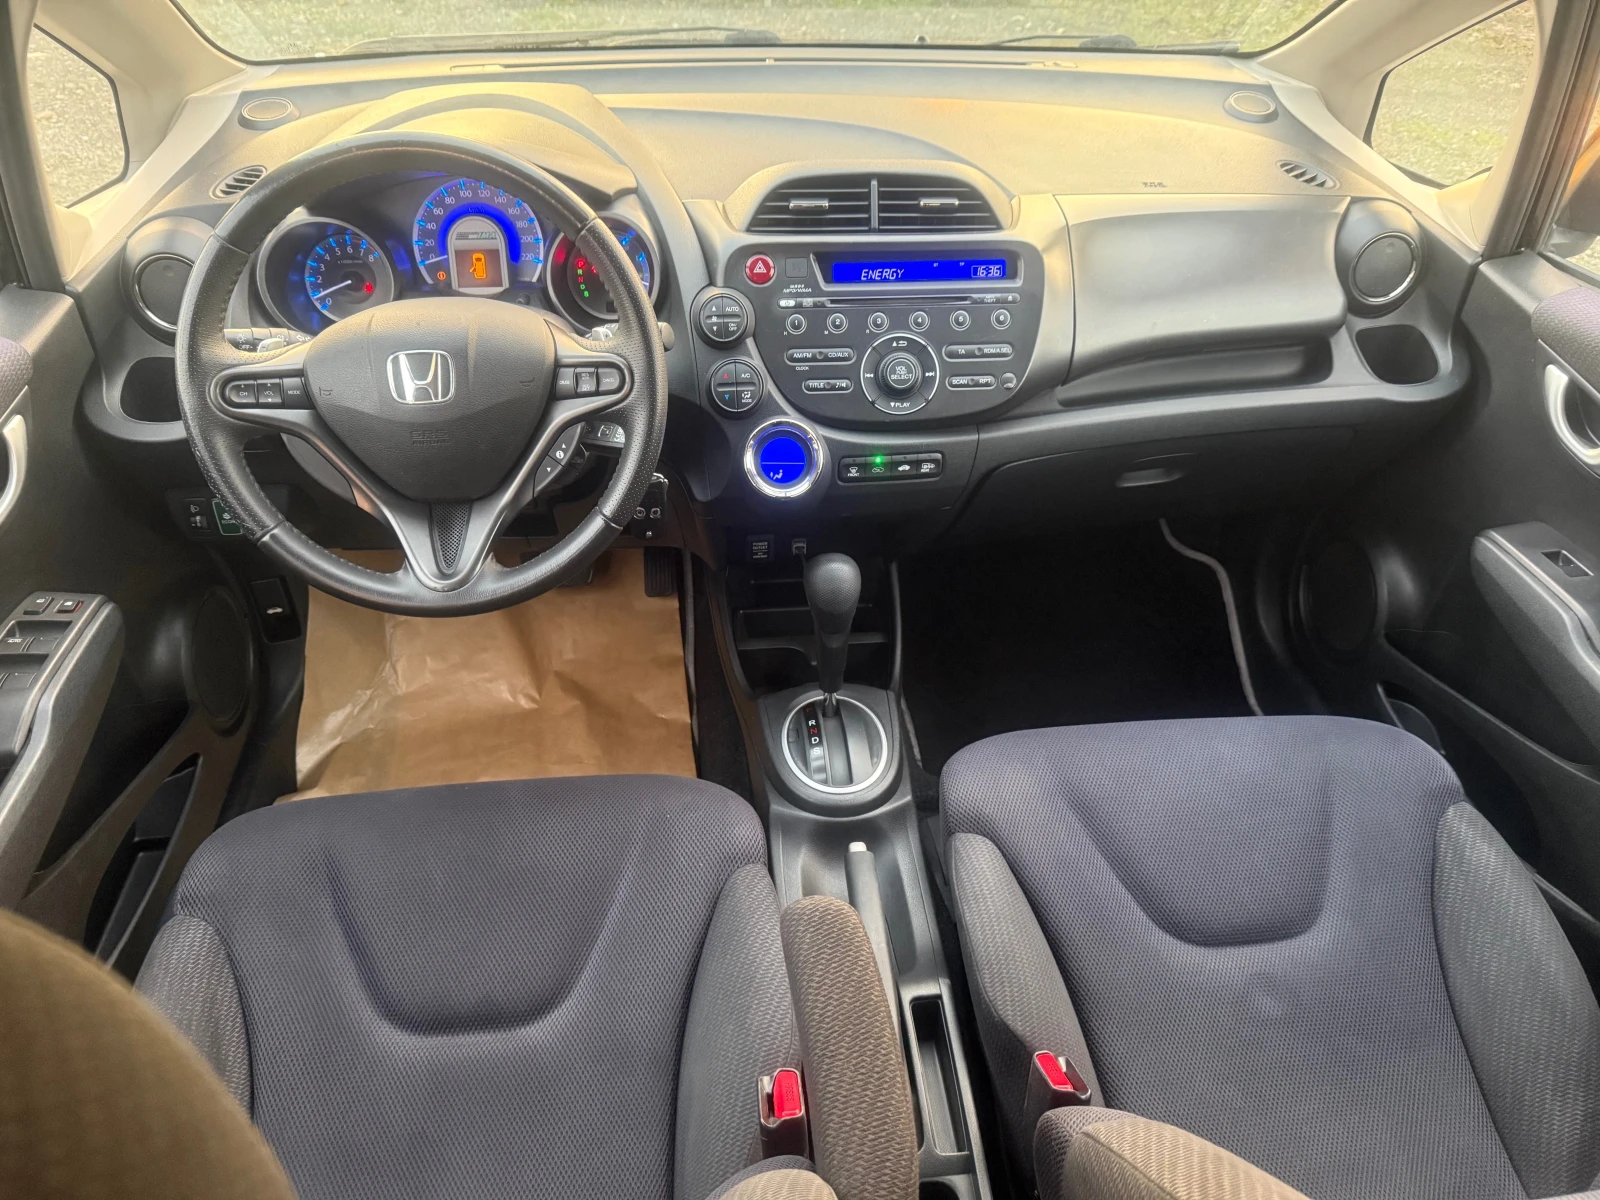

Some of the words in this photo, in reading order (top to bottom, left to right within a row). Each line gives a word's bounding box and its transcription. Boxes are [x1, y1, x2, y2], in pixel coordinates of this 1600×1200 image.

[459, 190, 472, 198] 100
[478, 190, 490, 198] 120
[444, 196, 455, 204] 80
[494, 196, 507, 204] 140
[433, 208, 443, 216] 60
[507, 207, 519, 215] 160
[425, 222, 436, 230] 40
[520, 235, 534, 243] 200
[335, 247, 341, 255] 5
[347, 246, 353, 254] 6
[359, 248, 364, 256] 7
[324, 253, 330, 261] 4
[368, 254, 374, 262] 8
[319, 263, 325, 271] 3
[861, 268, 905, 281] ENERGY
[976, 266, 1001, 277] 16:36
[316, 275, 323, 283] 2
[325, 297, 332, 305] 0
[999, 314, 1005, 322] 6
[809, 719, 816, 727] R
[813, 746, 821, 755] S
